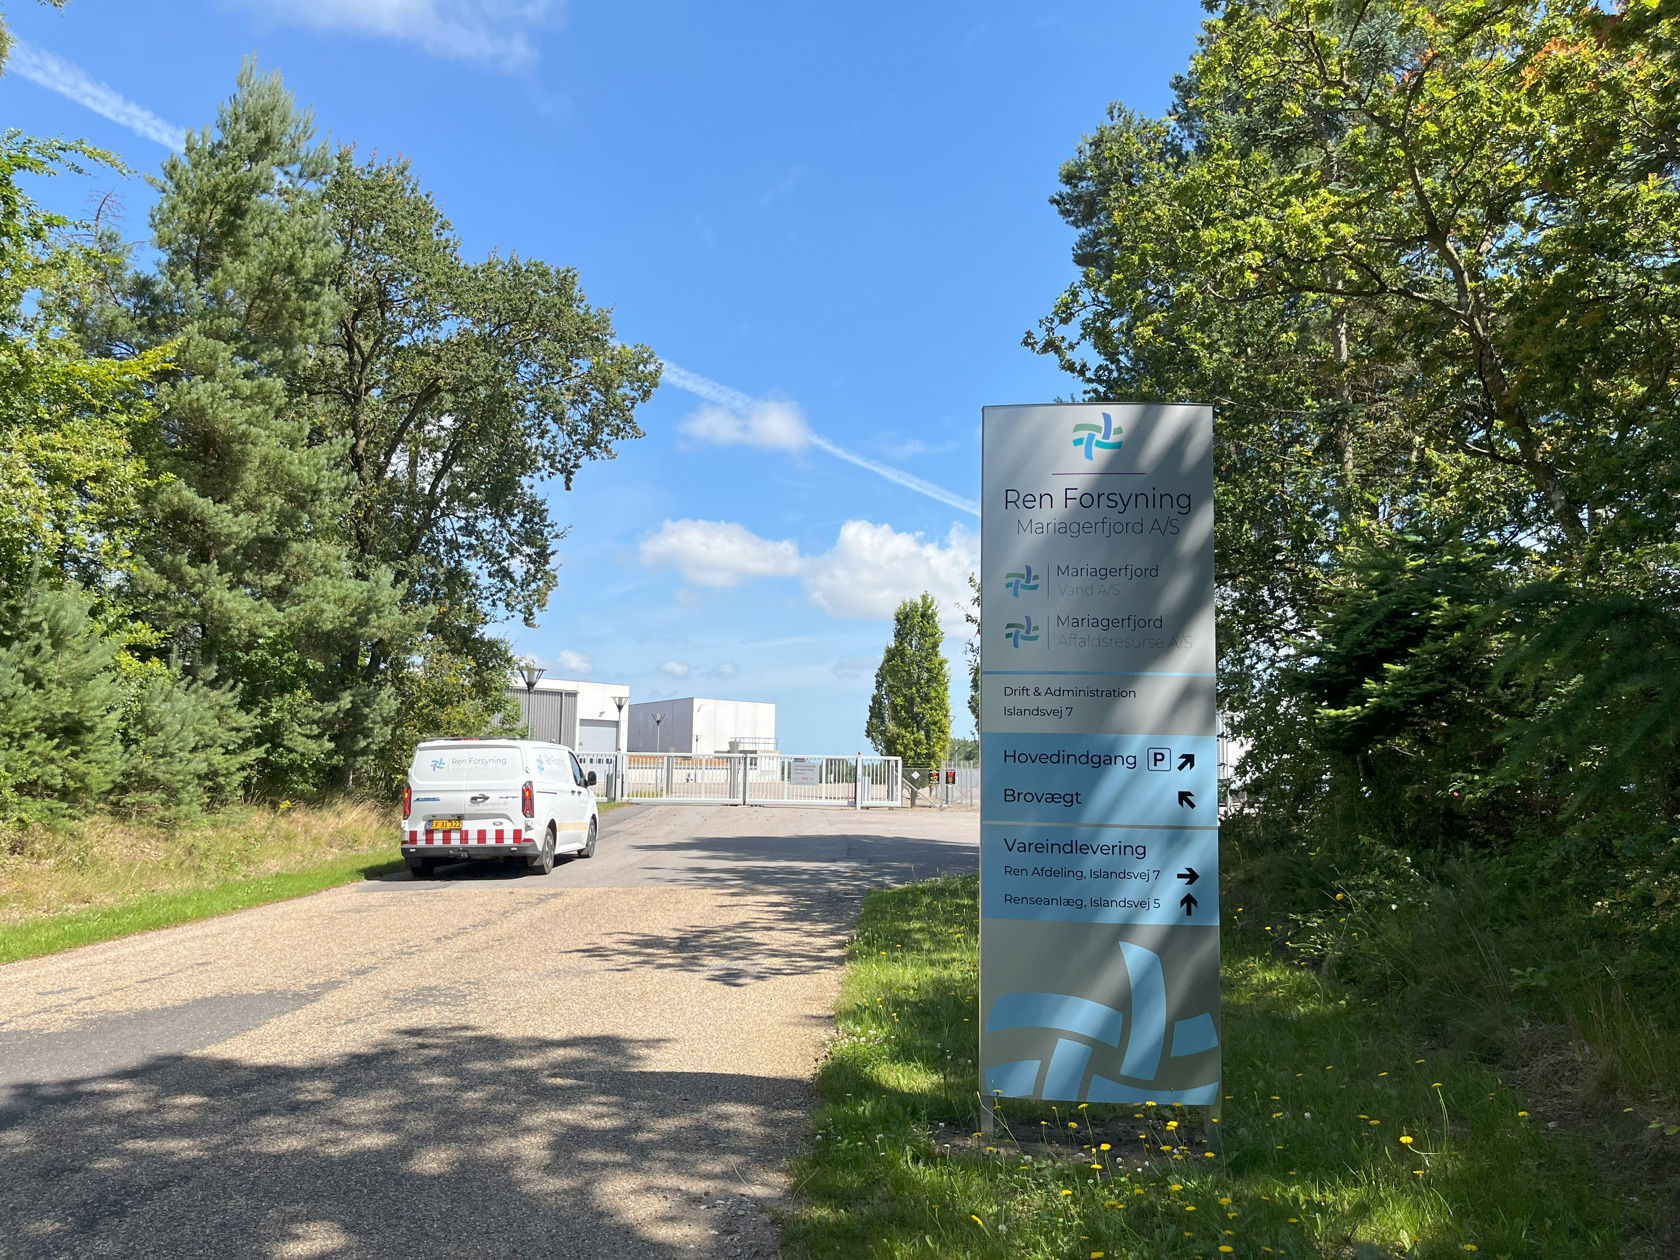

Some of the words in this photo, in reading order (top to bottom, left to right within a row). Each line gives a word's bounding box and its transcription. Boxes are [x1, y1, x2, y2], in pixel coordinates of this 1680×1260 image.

[1004, 488, 1053, 510] Ren
[1064, 487, 1191, 515] Forsyning
[1017, 517, 1144, 538] Mariagerfjord
[1149, 516, 1180, 536] A/S
[1056, 564, 1159, 580] Mariagerfjord
[1058, 584, 1094, 596] Vand
[1097, 583, 1121, 597] A/S
[1056, 614, 1163, 631] Mariagerfjord
[1057, 633, 1164, 649] Affaldsresurse
[1168, 634, 1193, 650] A/S
[1003, 686, 1030, 697] Drift
[1033, 686, 1042, 697] &
[1044, 686, 1137, 698] Administration
[1003, 706, 1063, 719] Islandsvej
[1065, 707, 1074, 717] 7
[451, 757, 467, 765] Ren
[468, 757, 507, 766] Forsyning
[1003, 749, 1137, 769] Hovedindgang
[1153, 752, 1165, 767] P
[1003, 788, 1082, 808] Brovægt
[1004, 838, 1147, 859] Vareindlevering
[1004, 865, 1028, 877] Ren
[1031, 866, 1087, 881] Afdeling,
[1089, 868, 1150, 882] Islandsvej
[1152, 869, 1161, 880] 7
[1004, 893, 1087, 910] Renseanlæg,
[1089, 896, 1150, 911] Islandsvej
[1152, 898, 1161, 909] 5
